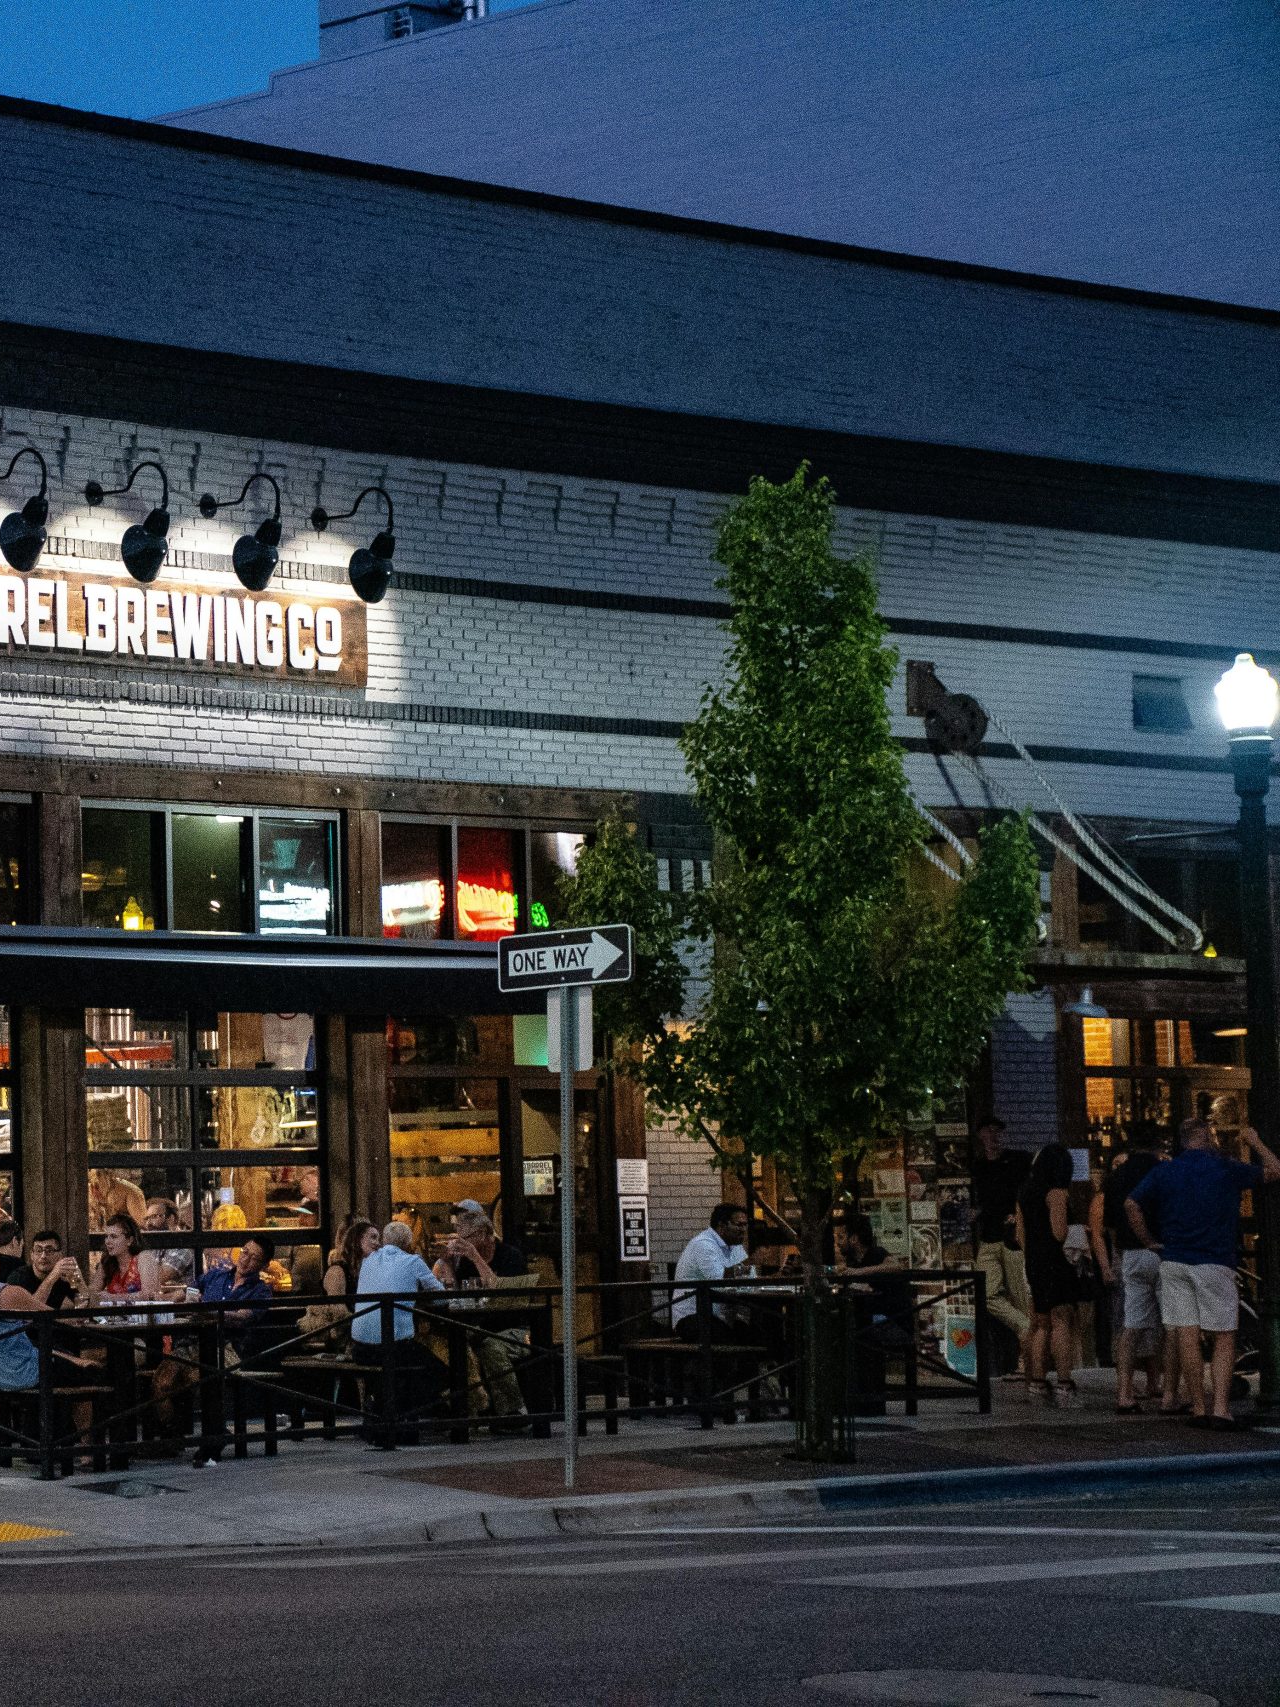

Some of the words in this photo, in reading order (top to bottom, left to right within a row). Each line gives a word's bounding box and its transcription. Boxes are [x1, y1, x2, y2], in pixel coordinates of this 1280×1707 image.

[83, 582, 285, 668] BREWING
[513, 950, 547, 973] ONE
[553, 946, 589, 970] WAY
